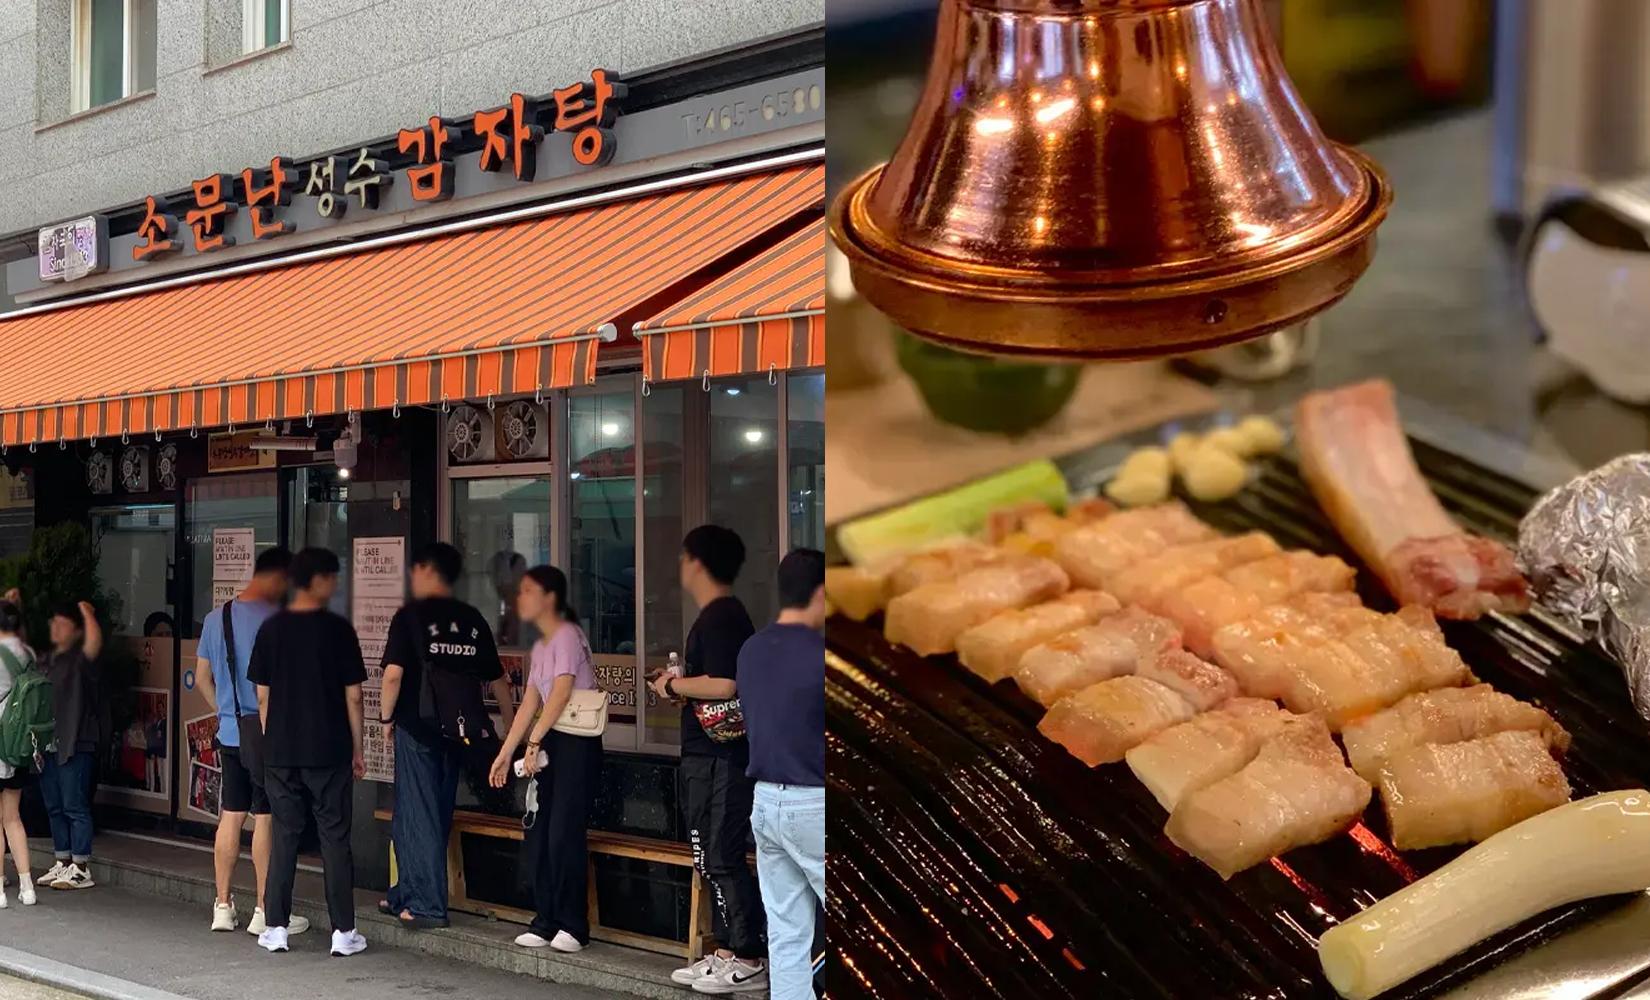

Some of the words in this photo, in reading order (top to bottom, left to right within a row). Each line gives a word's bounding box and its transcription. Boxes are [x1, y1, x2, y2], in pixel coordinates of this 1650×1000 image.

[131, 154, 290, 262] 소문난
[305, 147, 388, 218] 성수
[397, 67, 622, 202] 감자탕
[429, 641, 477, 656] STUDIO
[594, 664, 636, 687] 자랑의
